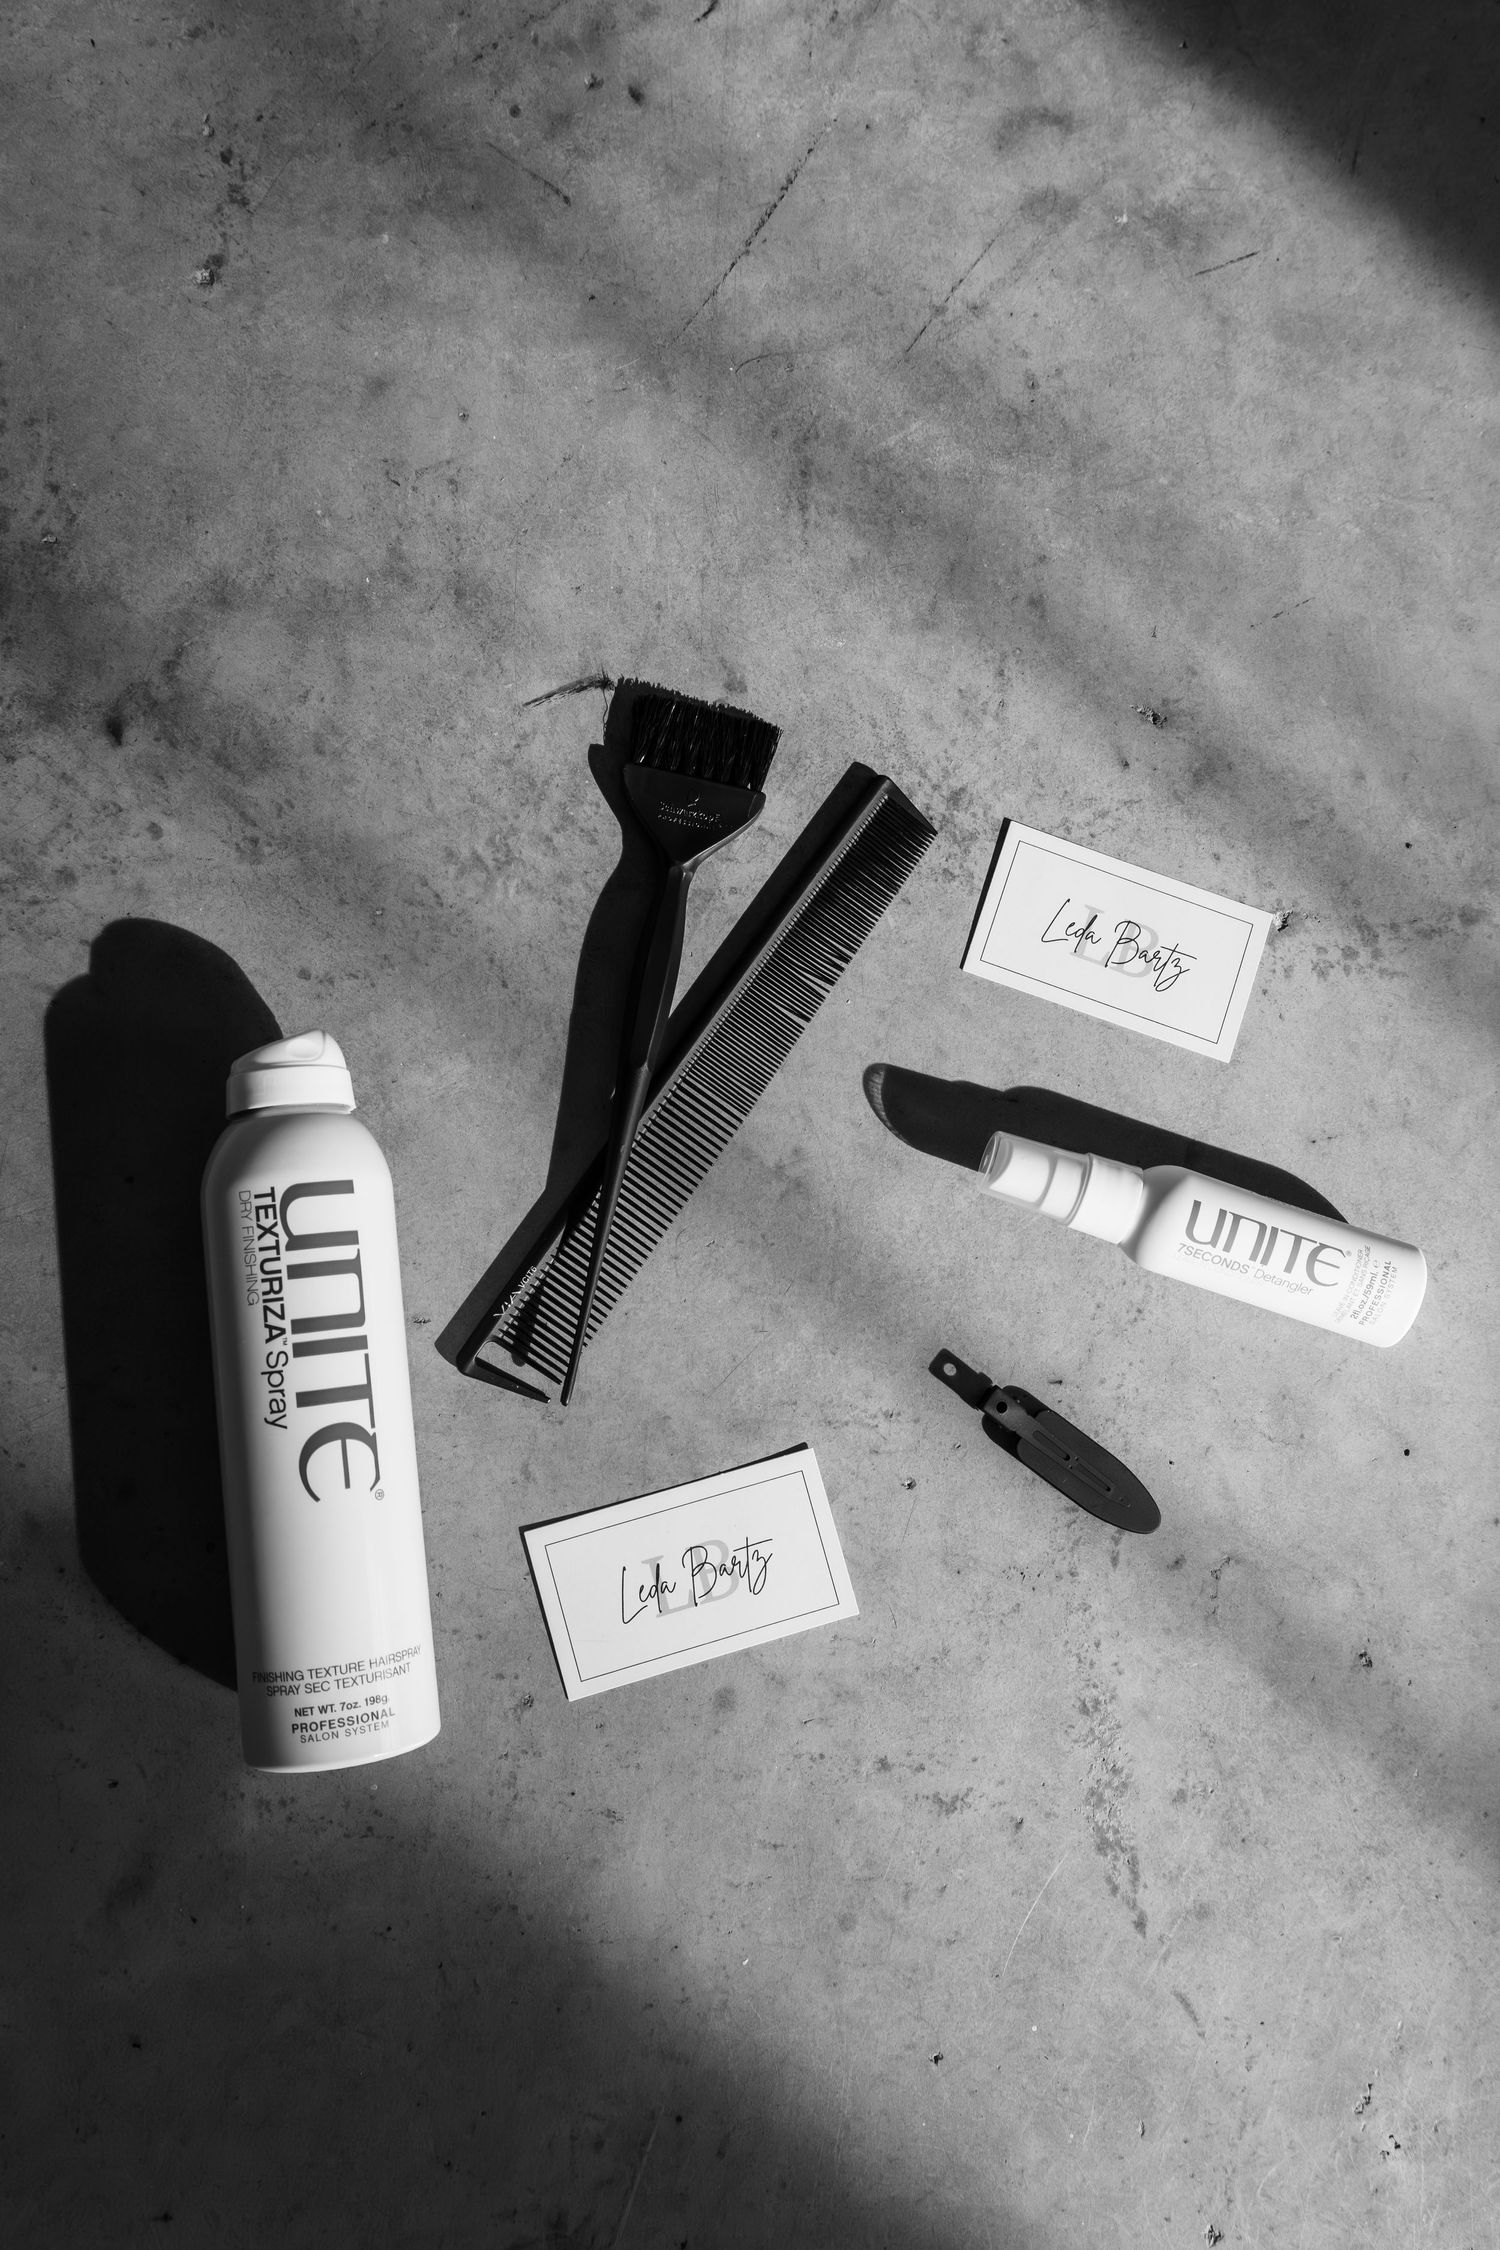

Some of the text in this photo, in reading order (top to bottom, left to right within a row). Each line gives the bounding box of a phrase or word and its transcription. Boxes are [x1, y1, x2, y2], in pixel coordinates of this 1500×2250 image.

[1041, 898, 1198, 992] Leda Bartz
[238, 1190, 260, 1307] DRY FINISHING
[1253, 1264, 1315, 1297] Detangler
[1358, 1260, 1392, 1326] PROFESSIONAL
[260, 1350, 289, 1430] Spray
[622, 1537, 773, 1624] Leda Bartz
[252, 1644, 422, 1684] FINISHING TEXTURE HAIRSPRAY
[266, 1662, 412, 1697] SPRAY SEC TEXTURISANT
[291, 1707, 397, 1735] PROFESSIONAL
[294, 1694, 389, 1718] NET WT. 7oz. 198g
[300, 1720, 391, 1744] SALON SYSTEM
